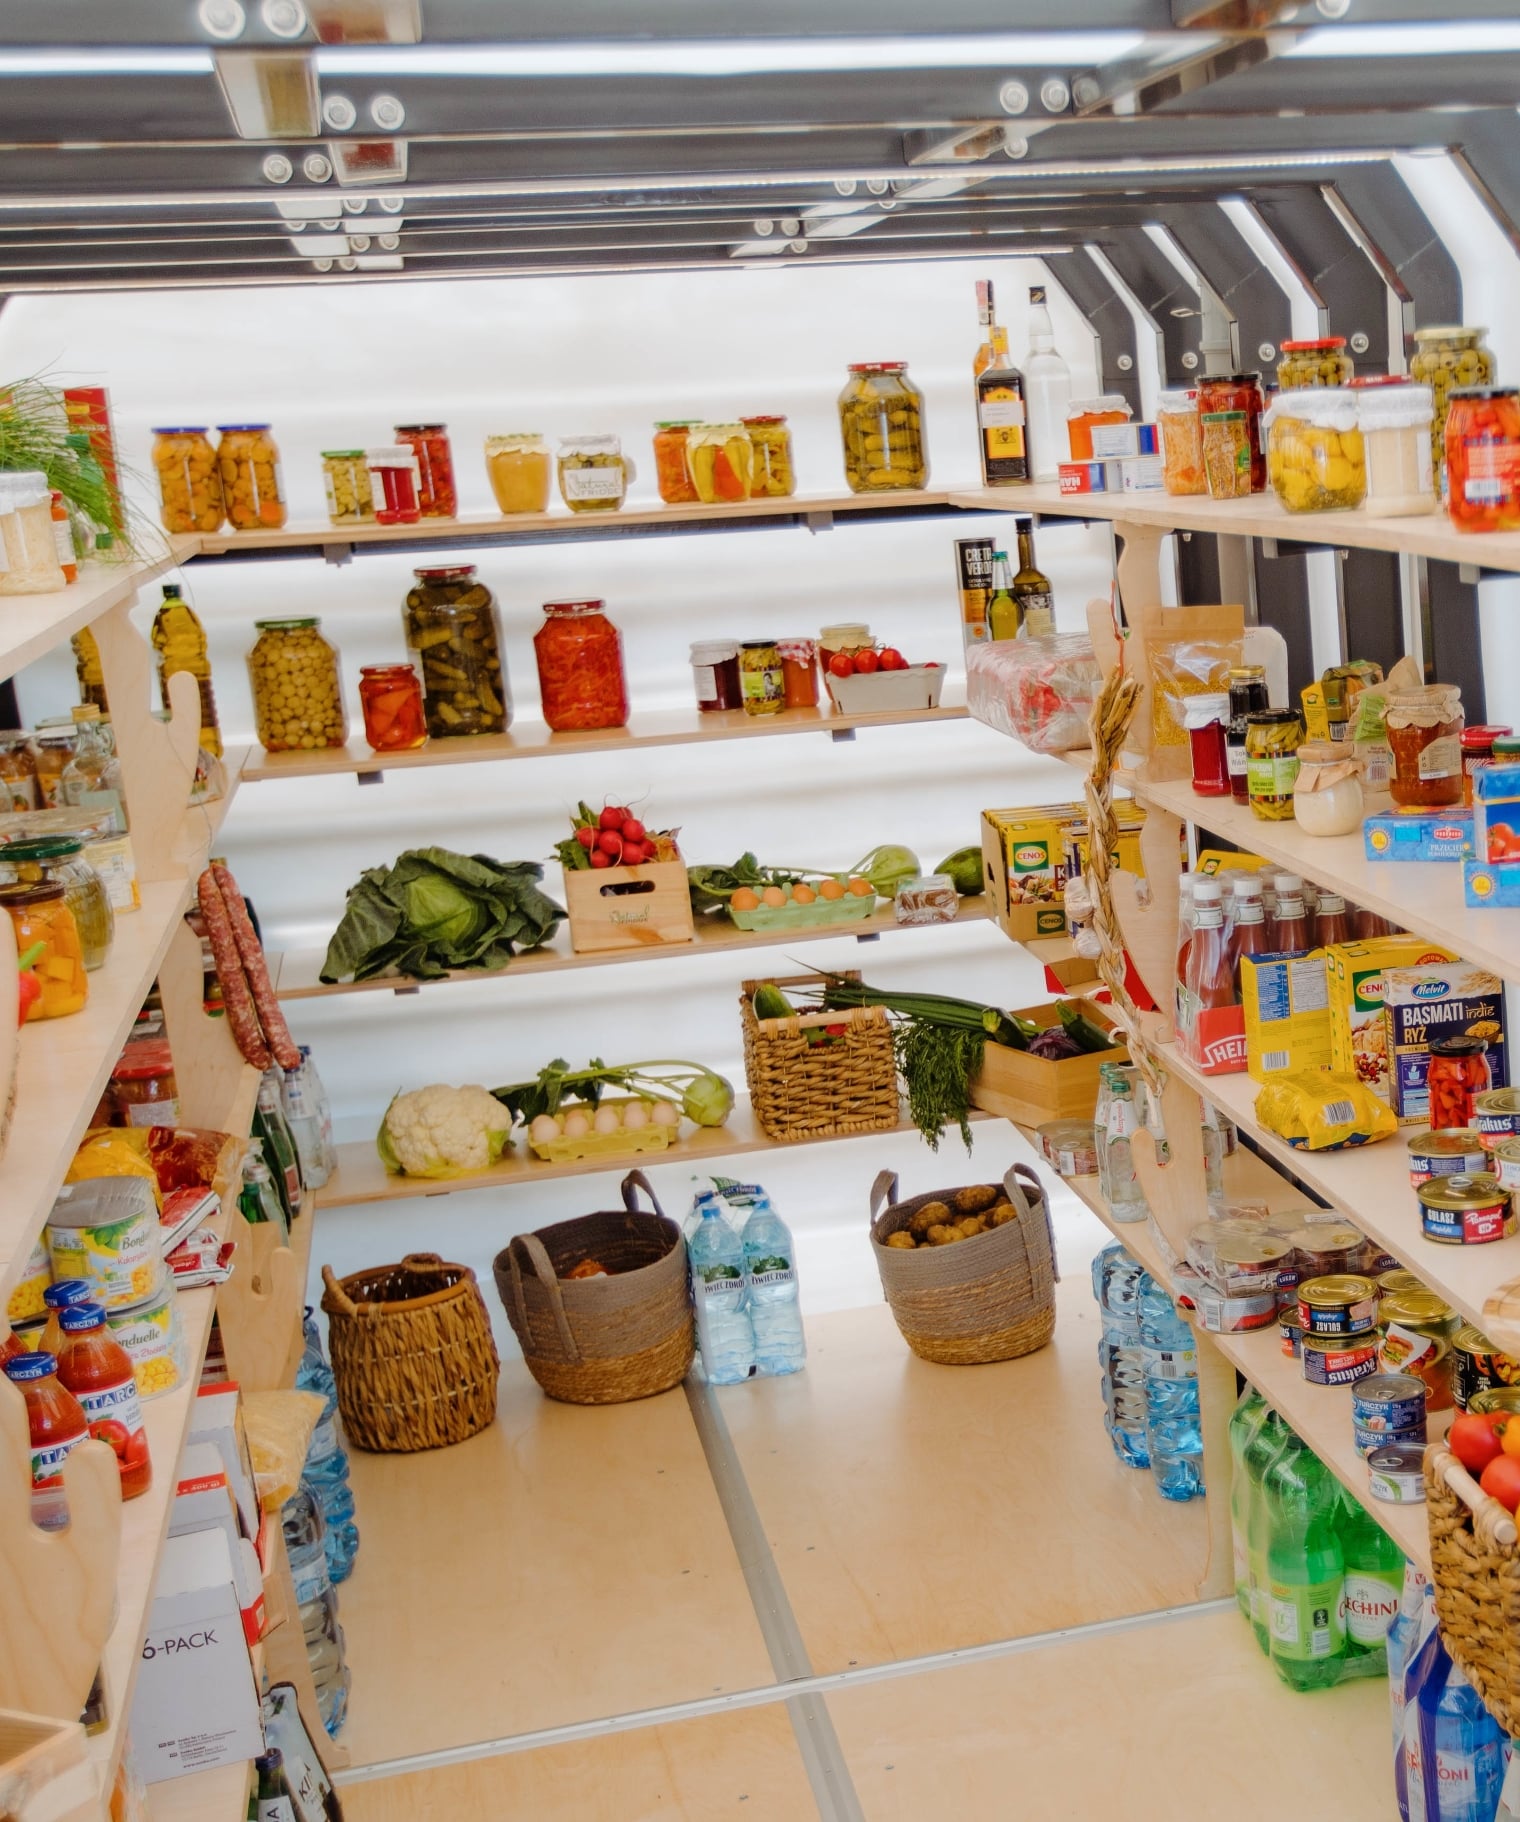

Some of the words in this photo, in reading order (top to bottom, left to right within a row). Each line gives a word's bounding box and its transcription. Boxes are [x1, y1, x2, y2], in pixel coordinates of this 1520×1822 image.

[1016, 852, 1045, 862] CENOS
[1040, 917, 1063, 926] CENOS
[1416, 984, 1447, 996] Melvit
[1402, 1002, 1464, 1027] BASMATI
[1466, 1001, 1496, 1021] indie
[1403, 1023, 1428, 1044] RYŻ
[1427, 1209, 1456, 1225] GULASZ
[751, 1273, 775, 1286] ŻYWIEC
[704, 1281, 726, 1294] YWIEC
[64, 1317, 100, 1331] TARCZYN
[142, 1629, 219, 1660] 6-PACK
